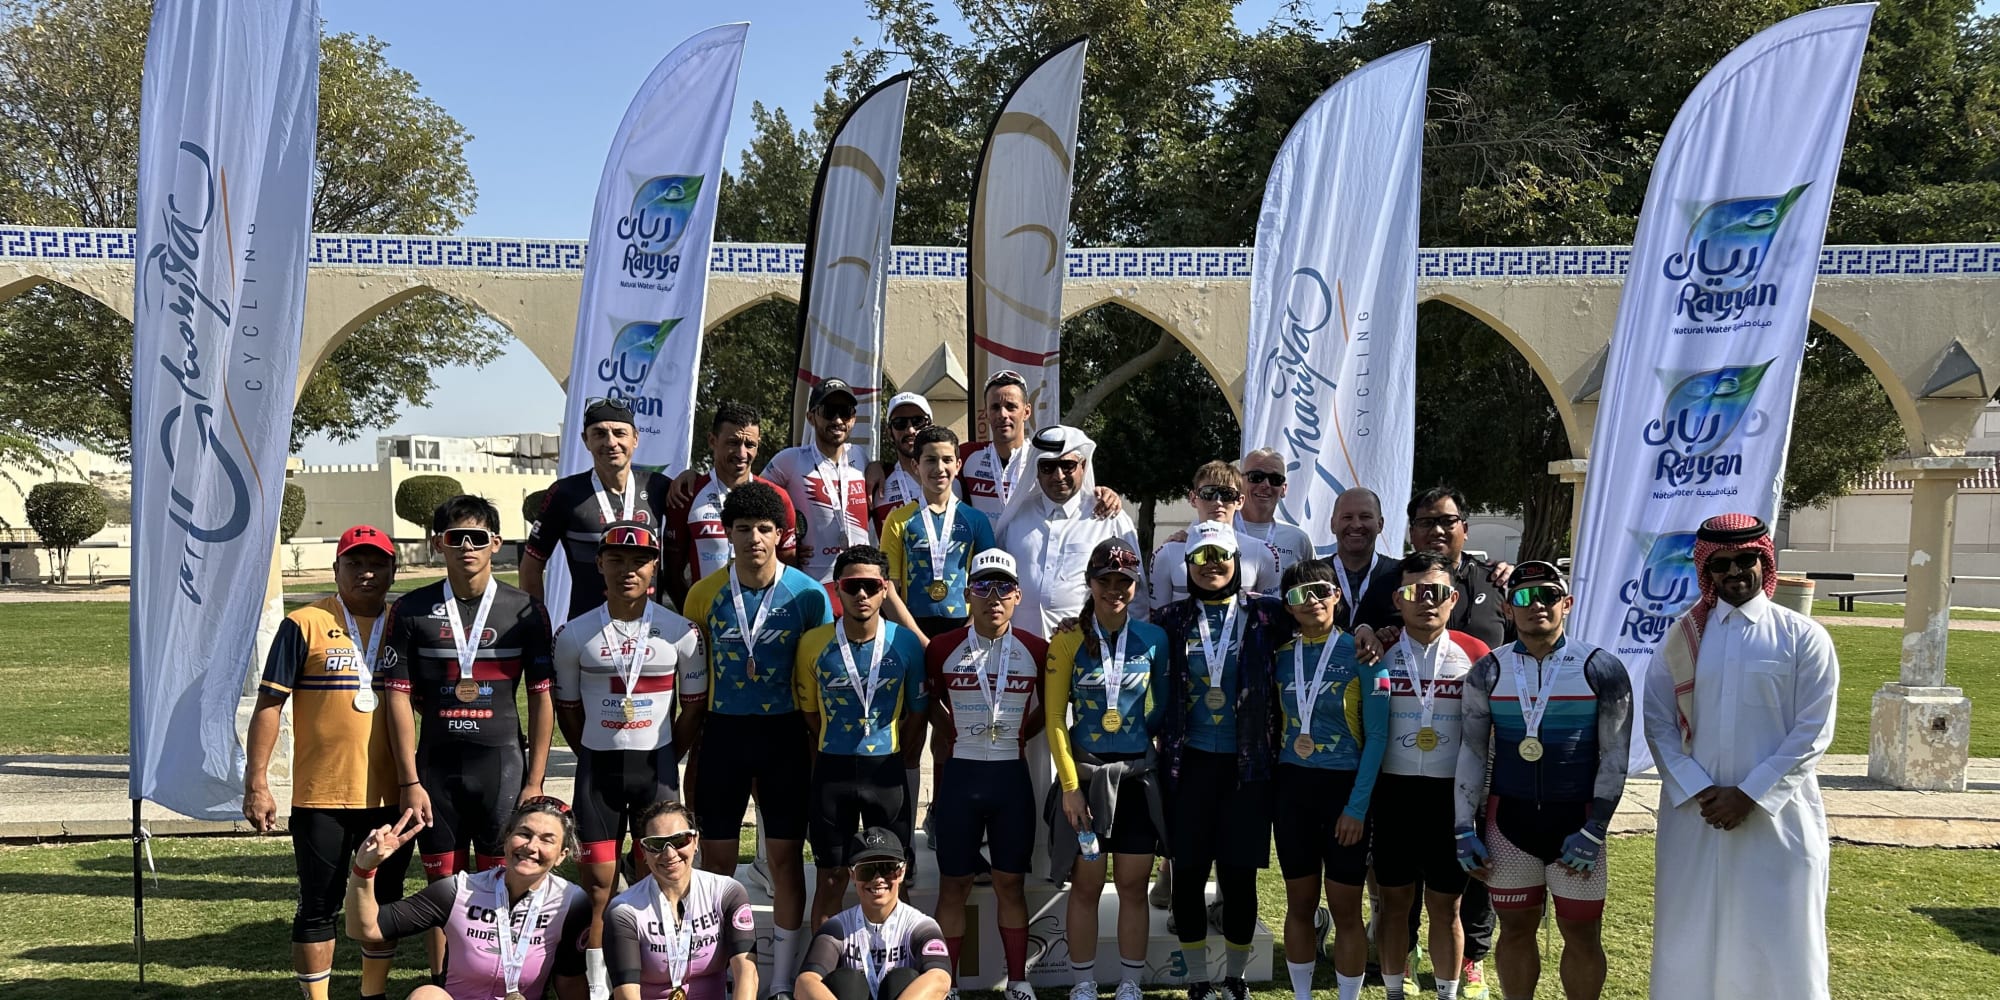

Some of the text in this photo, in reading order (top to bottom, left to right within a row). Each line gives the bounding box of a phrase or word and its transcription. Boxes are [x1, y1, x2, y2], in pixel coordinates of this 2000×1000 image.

[622, 243, 680, 280] Rayya
[1676, 282, 1777, 322] Rayyan
[1673, 325, 1731, 335] Natural Water
[1356, 311, 1370, 437] CYCLING
[1655, 449, 1742, 487] Rayyan
[466, 928, 496, 942] RIDE
[650, 943, 668, 953] RID
